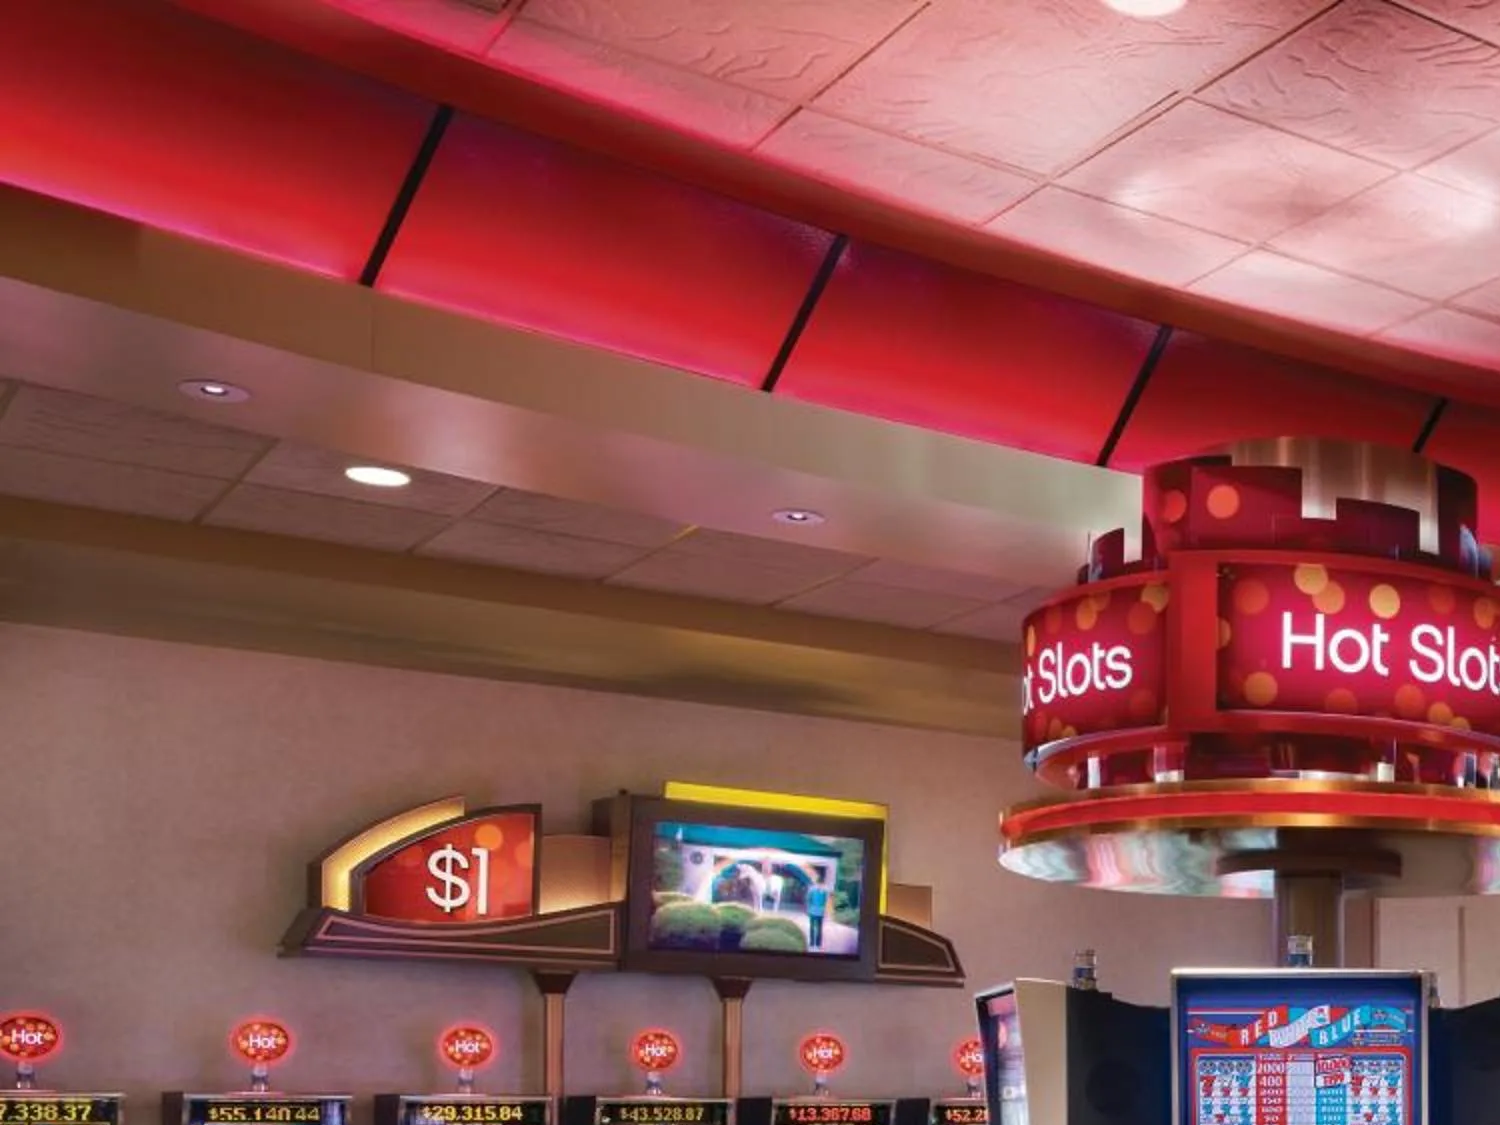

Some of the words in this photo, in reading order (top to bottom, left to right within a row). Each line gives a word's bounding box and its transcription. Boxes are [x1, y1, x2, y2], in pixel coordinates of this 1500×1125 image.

[1281, 611, 1390, 676] Hot
[1038, 641, 1132, 704] Slots
[426, 843, 488, 915] $1
[11, 1028, 43, 1045] Hot
[1239, 1010, 1278, 1045] RED
[1319, 1007, 1361, 1045] BLUE
[249, 1033, 277, 1048] Hot
[455, 1039, 480, 1053] Hot
[1259, 1076, 1283, 1086] 400
